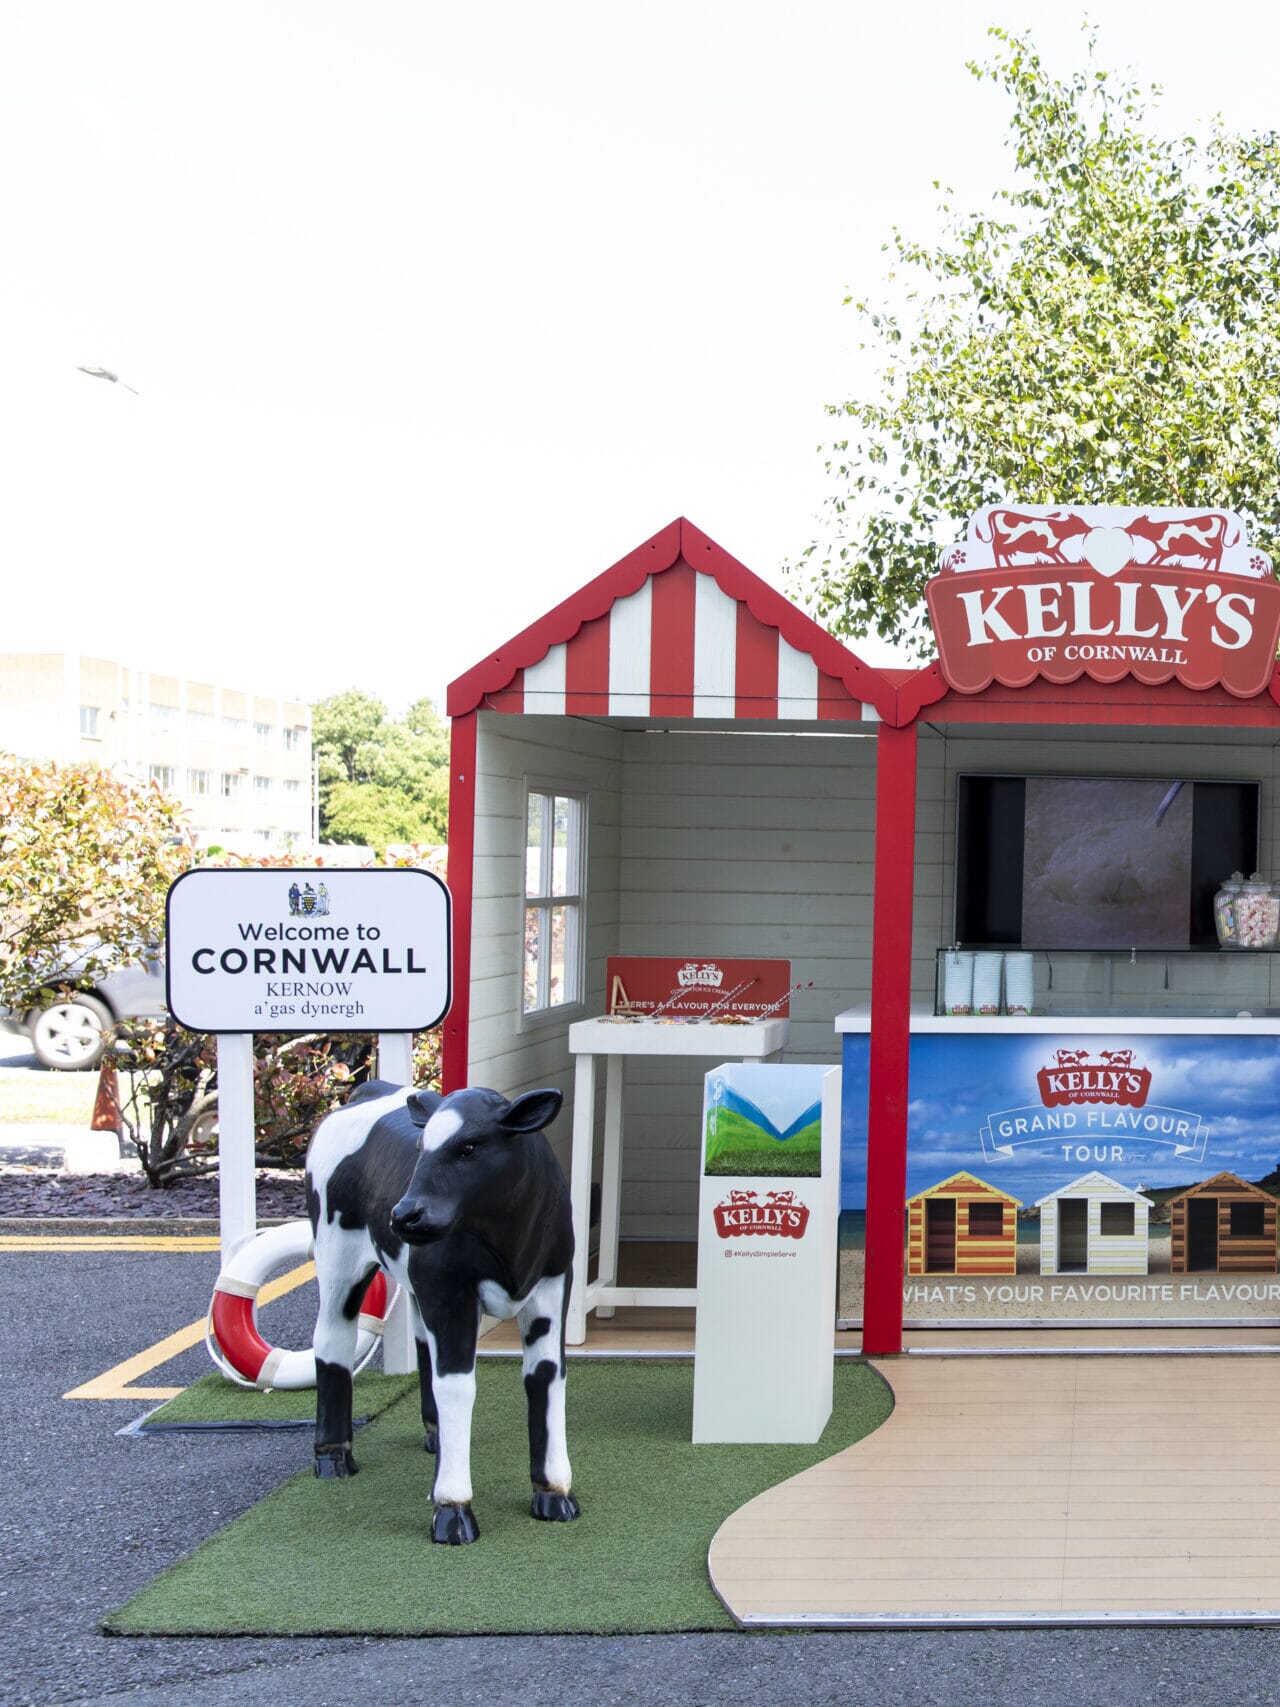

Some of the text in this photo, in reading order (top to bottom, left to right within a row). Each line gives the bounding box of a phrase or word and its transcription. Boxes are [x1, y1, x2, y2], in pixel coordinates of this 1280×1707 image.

[956, 581, 1256, 650] KELLY'S
[1027, 645, 1188, 664] OF CORNWALL
[238, 922, 381, 941] Welcome to
[192, 948, 426, 975] CORNWALL
[682, 971, 719, 981] KELLY'S
[266, 982, 352, 997] KERNOW
[254, 1000, 364, 1018] a'gas dynergh
[618, 1001, 655, 1009] TERE'S
[711, 1002, 729, 1010] FOR
[732, 1003, 781, 1011] EVERYONE
[1047, 1071, 1142, 1094] KELLY'S
[1080, 1091, 1120, 1099] CORNWALL
[999, 1111, 1190, 1137] GRAND FLAVOUR
[1062, 1145, 1124, 1162] TOUR
[722, 1208, 801, 1227] KELLY'S
[983, 1285, 1044, 1302] YOUR
[1051, 1285, 1174, 1301] FAVOURITE
